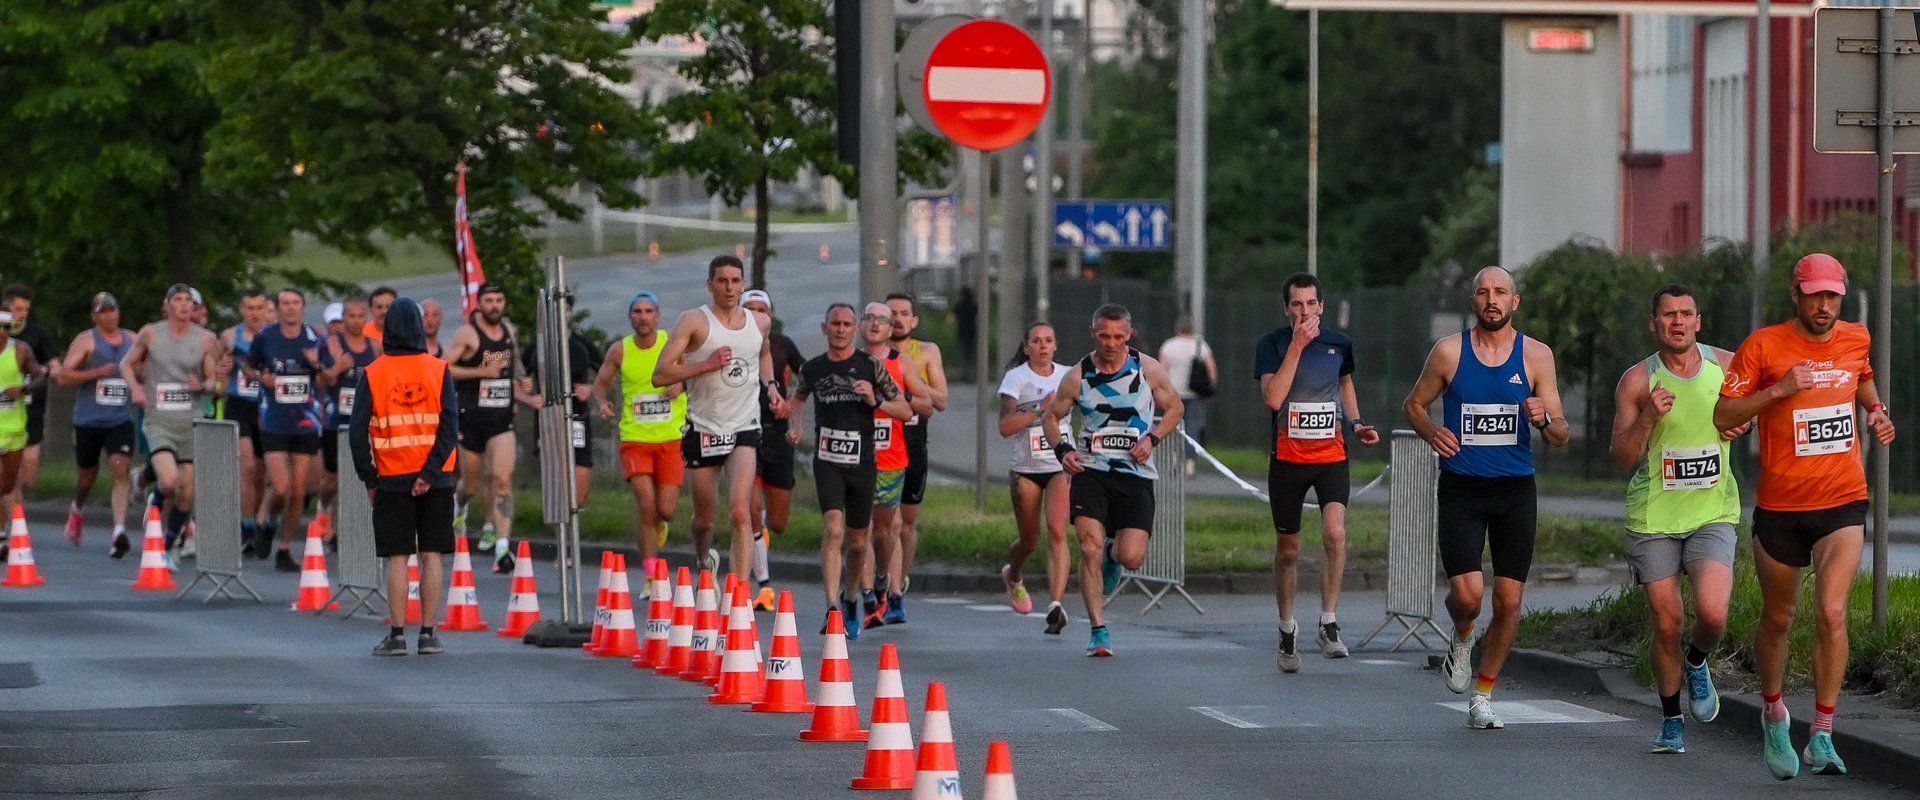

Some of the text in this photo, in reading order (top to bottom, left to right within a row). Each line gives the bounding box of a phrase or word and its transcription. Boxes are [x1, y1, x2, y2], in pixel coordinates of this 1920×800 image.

[1291, 414, 1334, 427] A 2897
[1465, 417, 1514, 432] E 4341
[1798, 418, 1852, 442] A 3620
[831, 440, 855, 454] 647
[1666, 459, 1717, 477] A 1574
